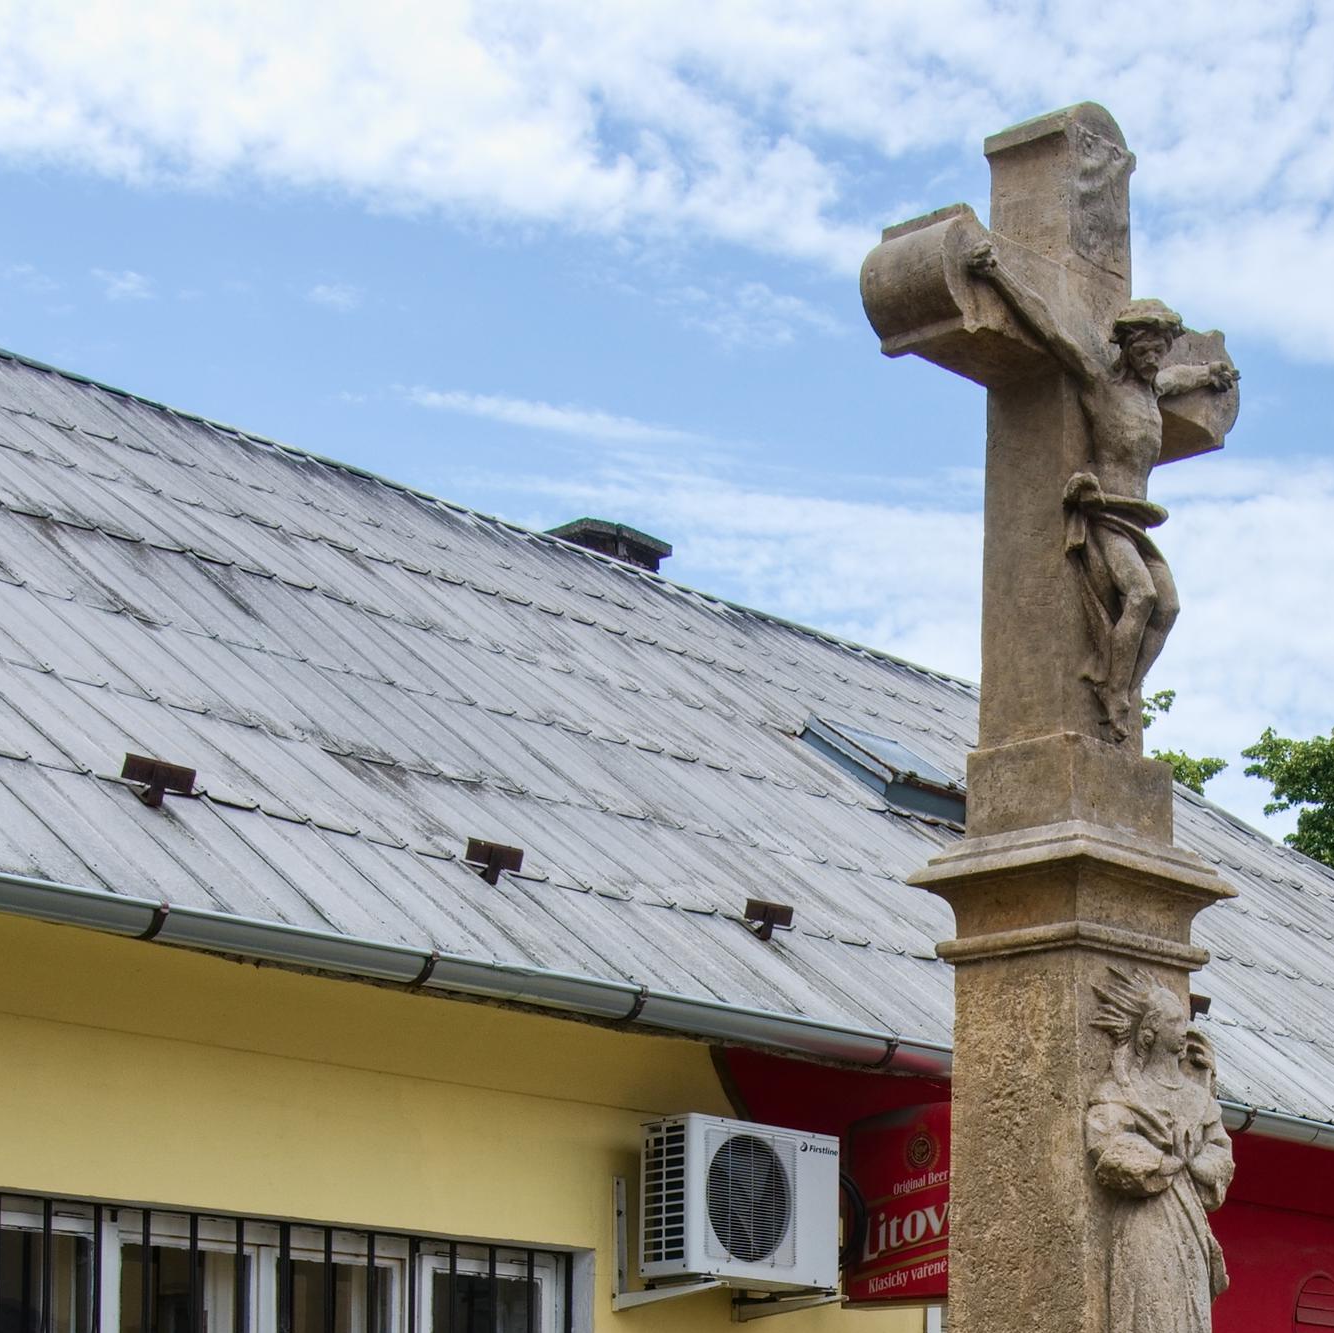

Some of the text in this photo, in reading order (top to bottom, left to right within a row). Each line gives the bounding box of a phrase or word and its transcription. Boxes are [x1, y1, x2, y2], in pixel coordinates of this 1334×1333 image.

[809, 1144, 839, 1157] Firstline
[893, 1169, 949, 1196] Original Beer
[863, 1201, 950, 1263] Litov
[868, 1269, 909, 1294] Klasicky
